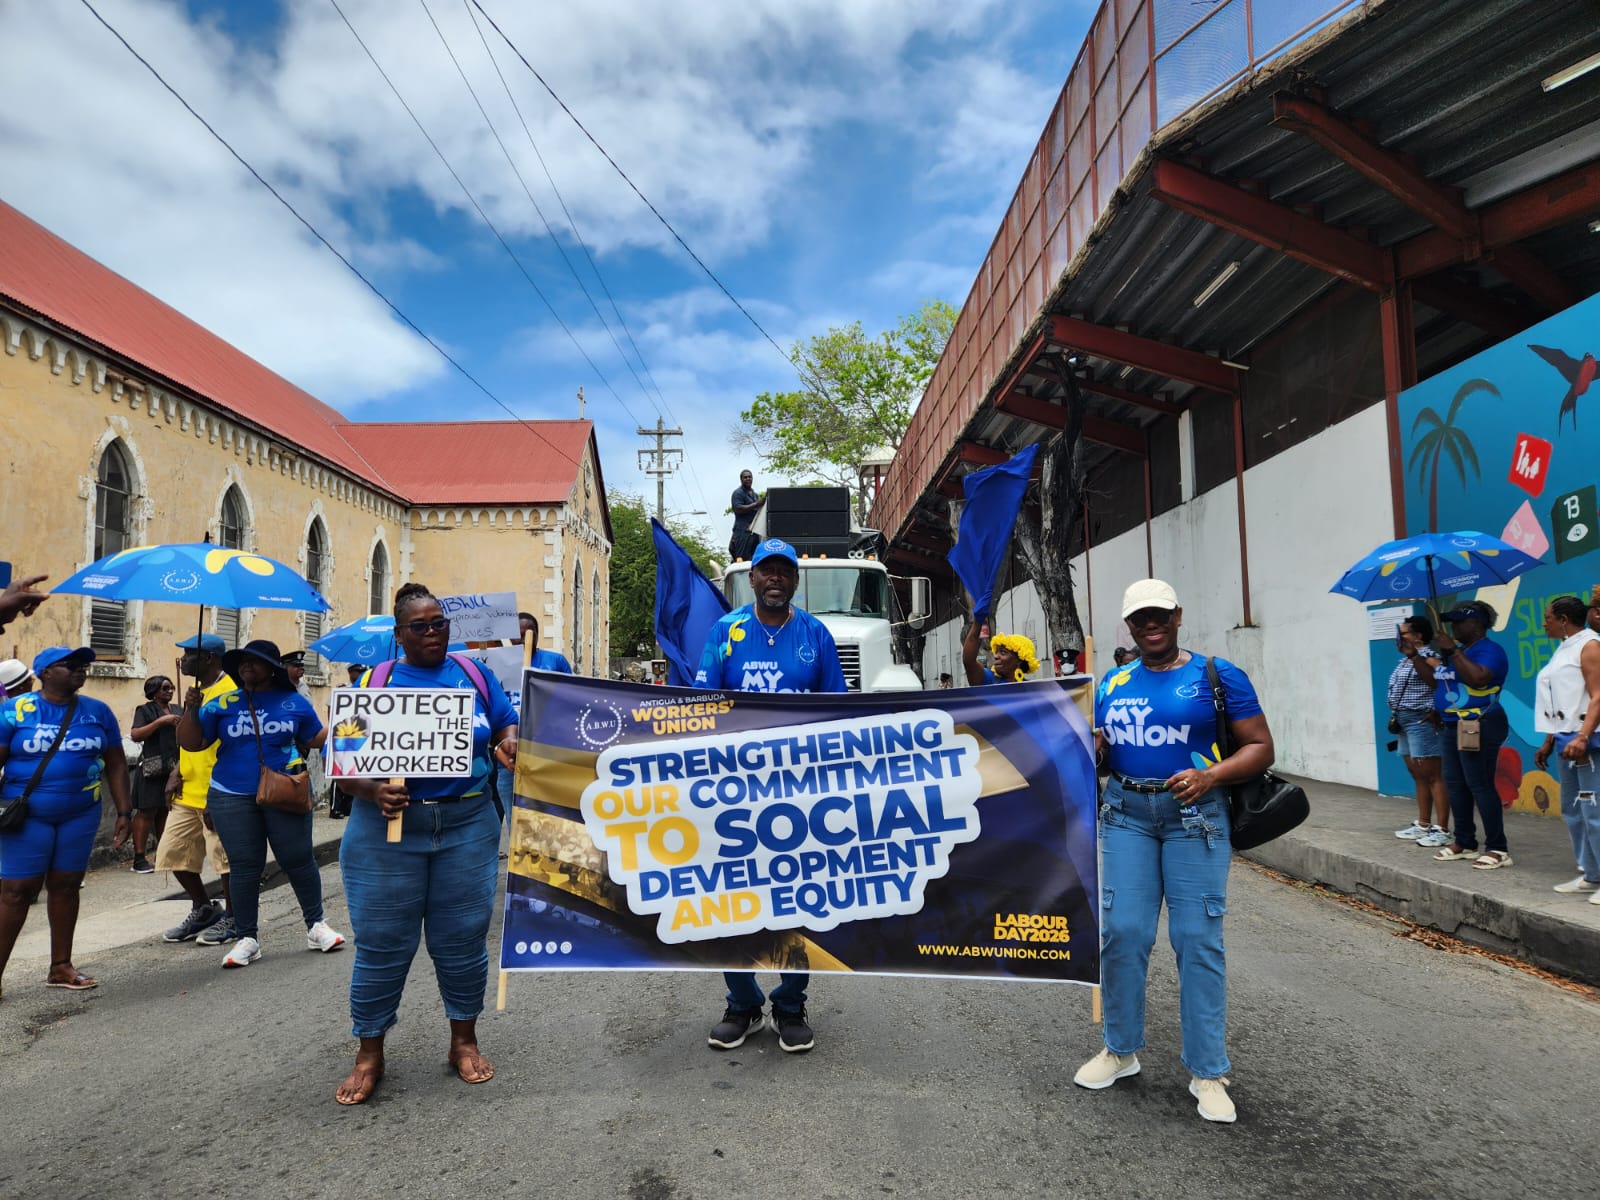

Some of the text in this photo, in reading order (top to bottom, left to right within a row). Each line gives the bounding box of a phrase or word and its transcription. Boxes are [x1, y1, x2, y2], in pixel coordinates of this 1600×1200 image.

[742, 661, 778, 671] ABWU
[741, 670, 784, 689] MY
[336, 694, 471, 715] PROTECT
[639, 693, 726, 707] ANTIGUA & BARBUDA
[1110, 697, 1149, 706] ABWU
[631, 699, 735, 722] WORKERS'
[1104, 705, 1154, 726] MY
[227, 720, 294, 738] UNION
[435, 717, 470, 730] THE
[652, 716, 716, 736] UNION
[370, 731, 469, 751] RIGHTS
[1101, 724, 1191, 747] UNION
[609, 719, 943, 787] STRENGTHENING
[353, 755, 469, 773] WORKERS
[592, 747, 967, 820] OUR COMMITMENT
[604, 784, 967, 871] TO SOCIAL
[639, 836, 941, 902] DEVELOPMENT
[670, 871, 918, 932] AND EQUITY
[995, 913, 1068, 929] LABOUR
[993, 927, 1071, 943] DAY2026
[918, 944, 1071, 961] WWW.ABWUNION.COM
